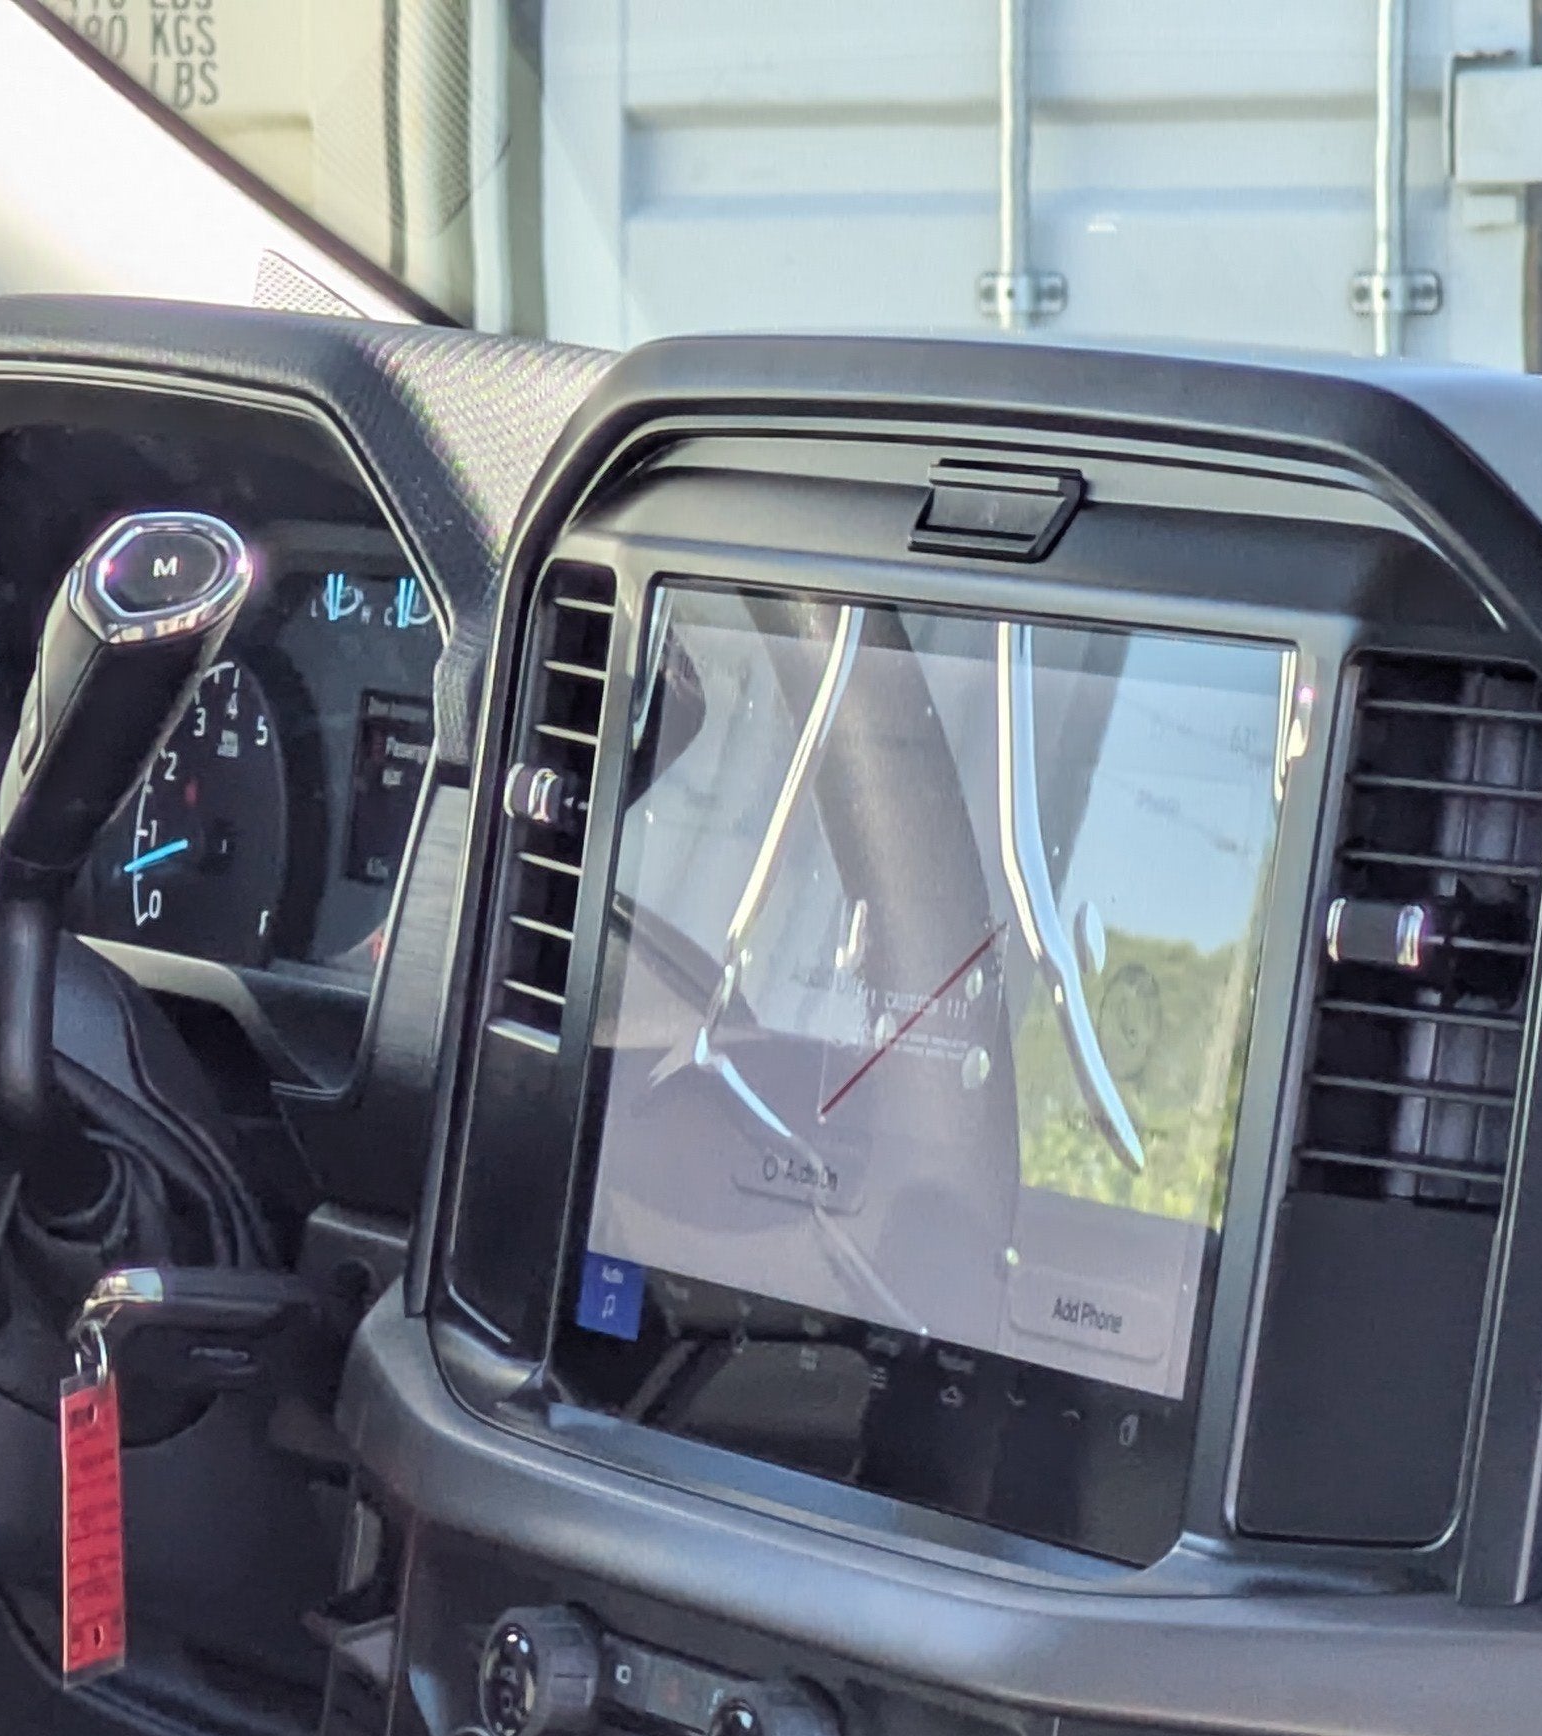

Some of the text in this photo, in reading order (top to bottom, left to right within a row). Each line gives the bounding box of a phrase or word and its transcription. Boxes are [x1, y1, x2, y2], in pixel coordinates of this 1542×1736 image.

[150, 13, 216, 58] KGS
[153, 557, 179, 578] M
[225, 692, 239, 720] 4
[193, 707, 206, 737] 3
[255, 715, 269, 746] 5
[164, 752, 177, 781] 2
[148, 889, 162, 919] 0
[1051, 1297, 1123, 1334] Add Phone
